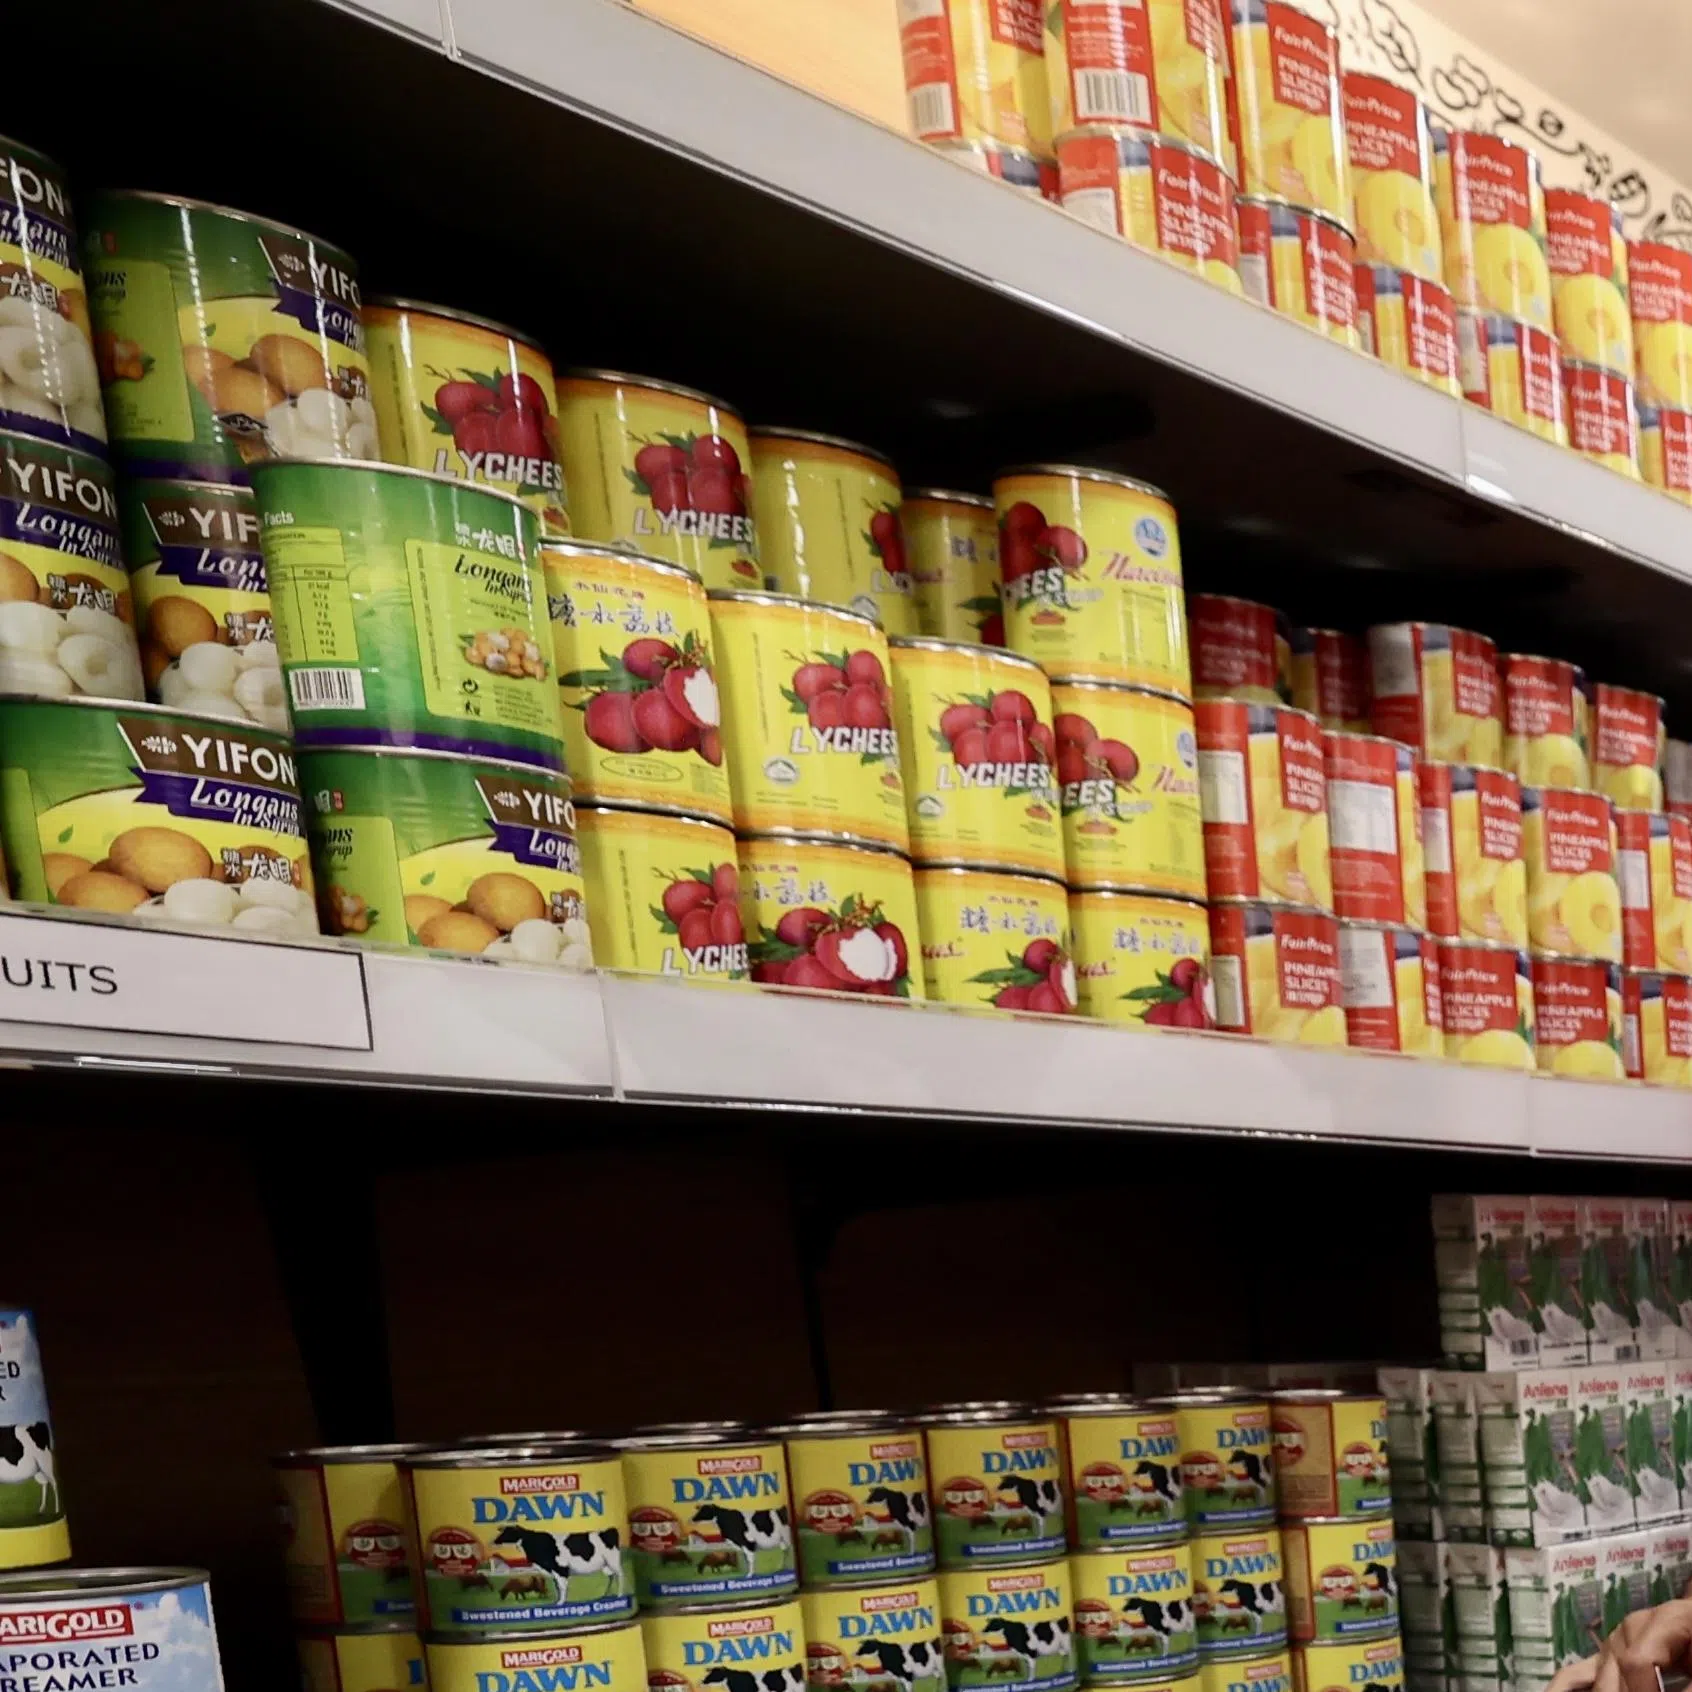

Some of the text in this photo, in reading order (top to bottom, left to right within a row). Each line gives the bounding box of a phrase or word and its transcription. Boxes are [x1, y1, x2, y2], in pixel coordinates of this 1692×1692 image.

[433, 446, 565, 491] LYCHEES
[188, 507, 263, 544] YIF
[633, 507, 756, 546] LYCHEES
[790, 725, 898, 756] LYCHEES
[182, 733, 297, 788] YIFON
[936, 761, 1051, 791] LYCHEES
[190, 777, 300, 823] Longans
[1281, 933, 1334, 956] FairPrice
[661, 942, 751, 978] LYCHEE
[1286, 975, 1329, 996] SLICES
[1443, 992, 1514, 1010] PINEAPPLE
[1537, 1004, 1604, 1020] PINEAPPLE
[502, 1474, 578, 1493] MARIGOLD
[472, 1491, 604, 1524] DAWN
[0, 1609, 126, 1637] ARIGOLD
[461, 1603, 529, 1621] Sweetened
[534, 1599, 591, 1619] Beverage
[503, 1646, 581, 1667] MARIGOLD
[683, 1630, 793, 1666] DAWN
